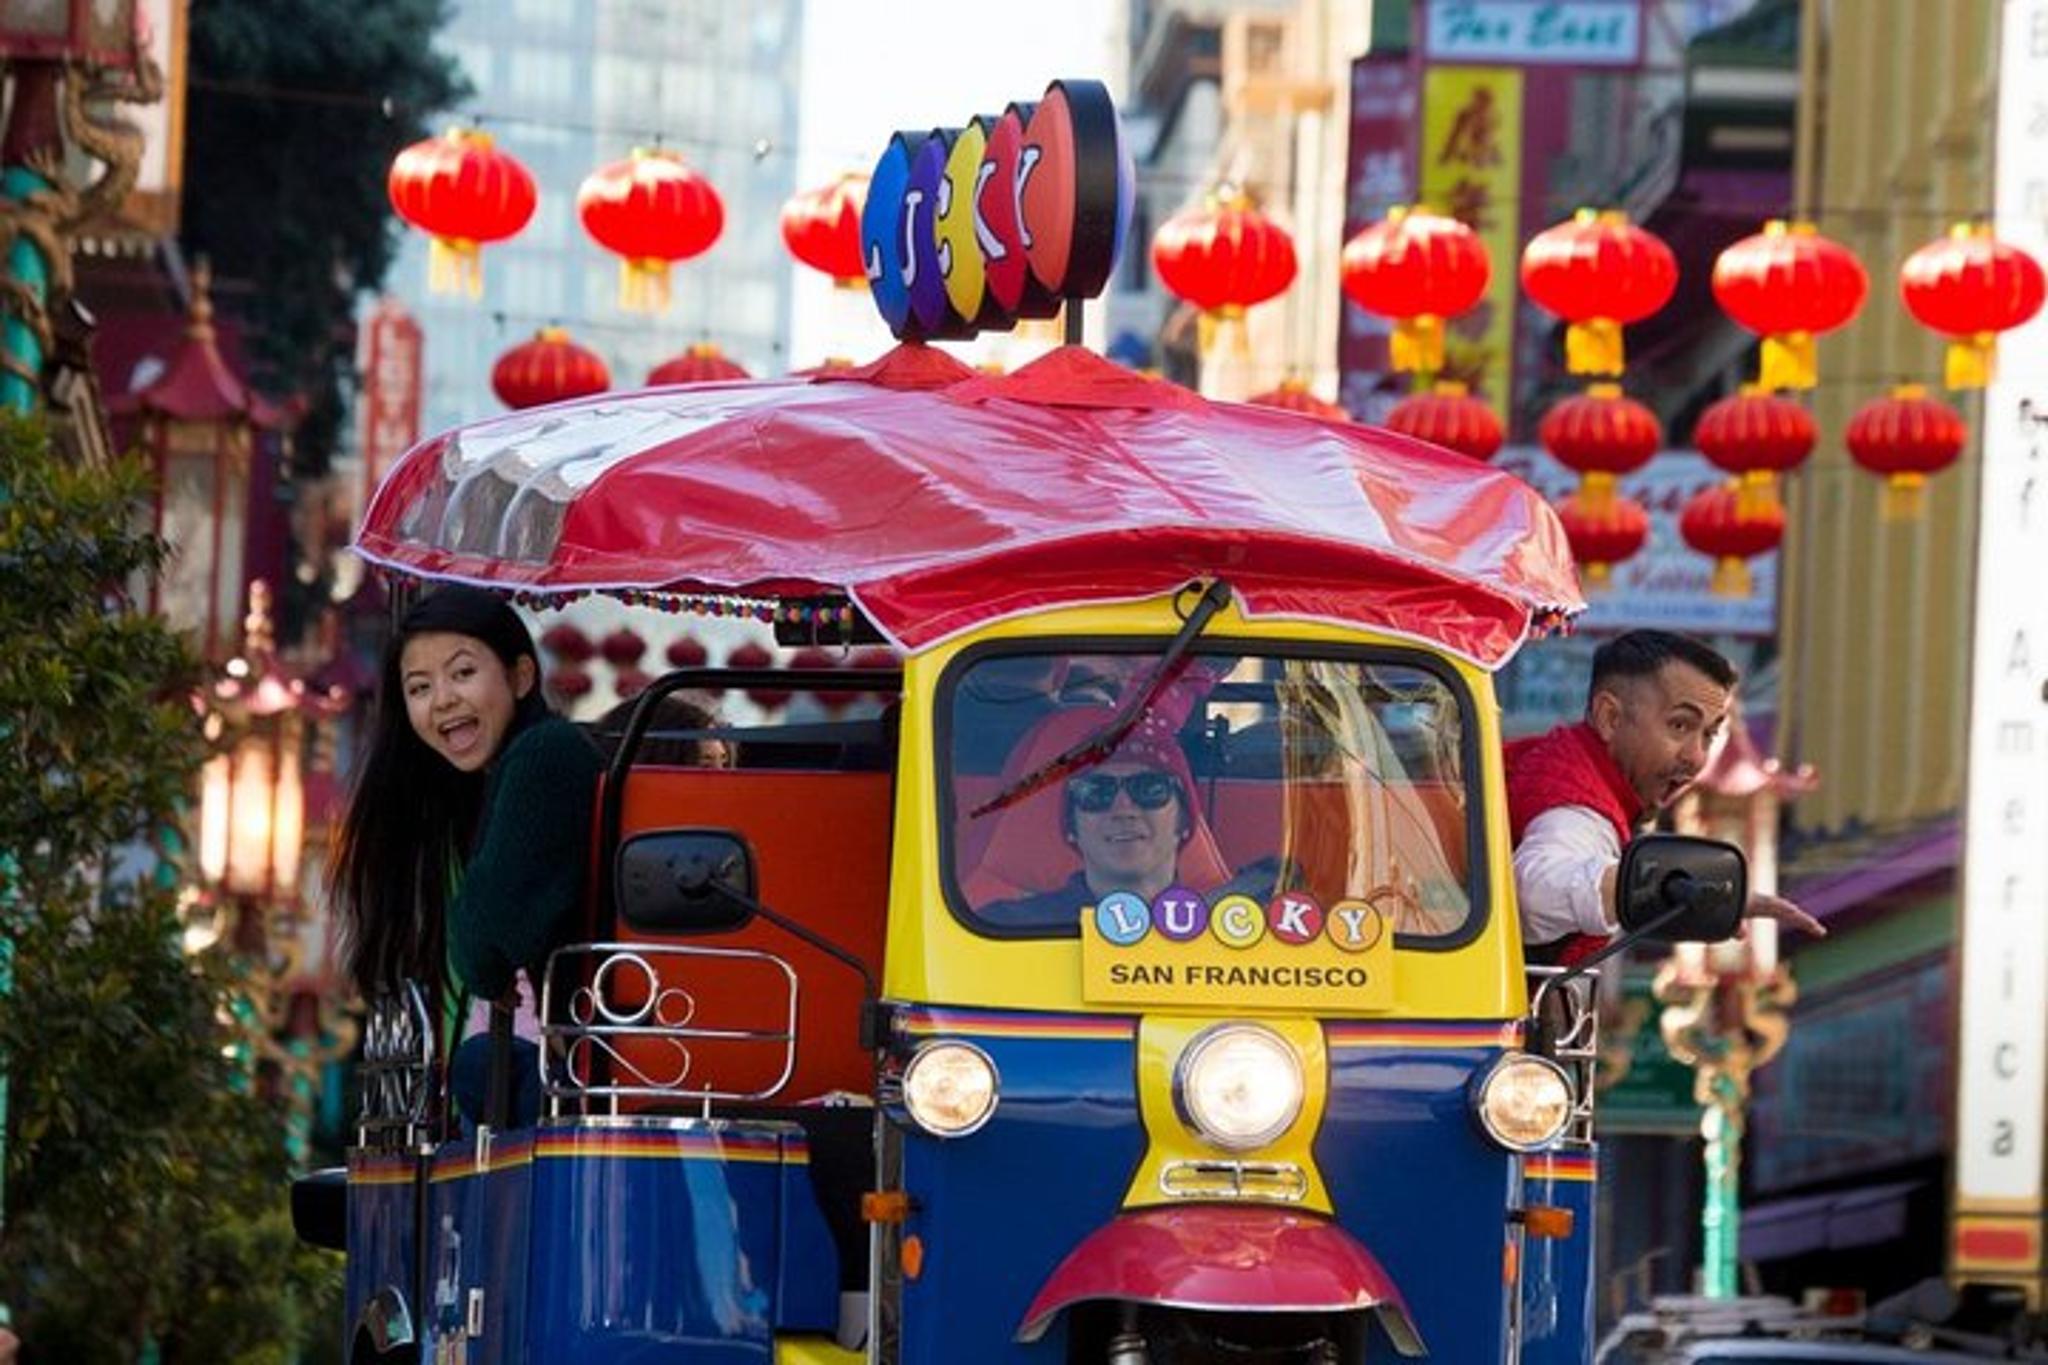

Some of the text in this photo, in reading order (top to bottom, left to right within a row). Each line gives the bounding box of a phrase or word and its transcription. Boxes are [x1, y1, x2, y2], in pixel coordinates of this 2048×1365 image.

[1989, 626, 2034, 1159] America
[1109, 898, 1372, 944] LUCKY
[1110, 962, 1369, 988] SAN FRANCISCO
